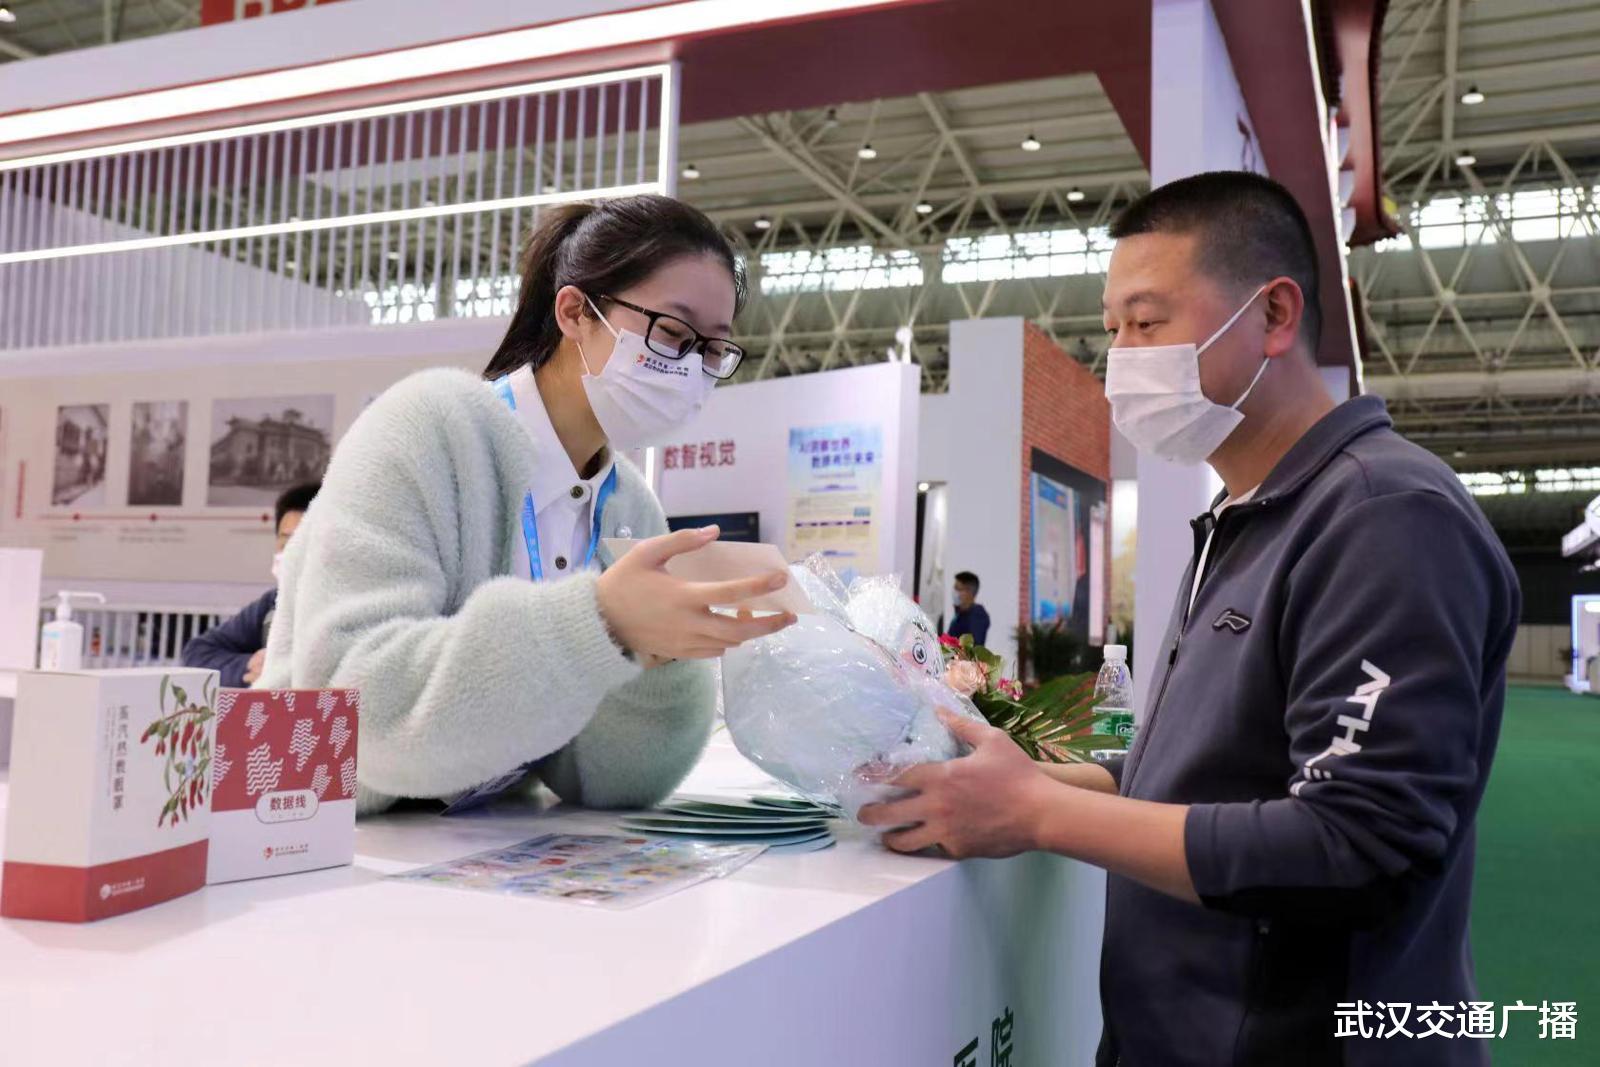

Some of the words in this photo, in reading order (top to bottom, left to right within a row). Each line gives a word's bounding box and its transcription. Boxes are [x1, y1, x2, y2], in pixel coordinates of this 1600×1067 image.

[664, 441, 735, 470] 数智视觉
[271, 794, 306, 810] 数据线
